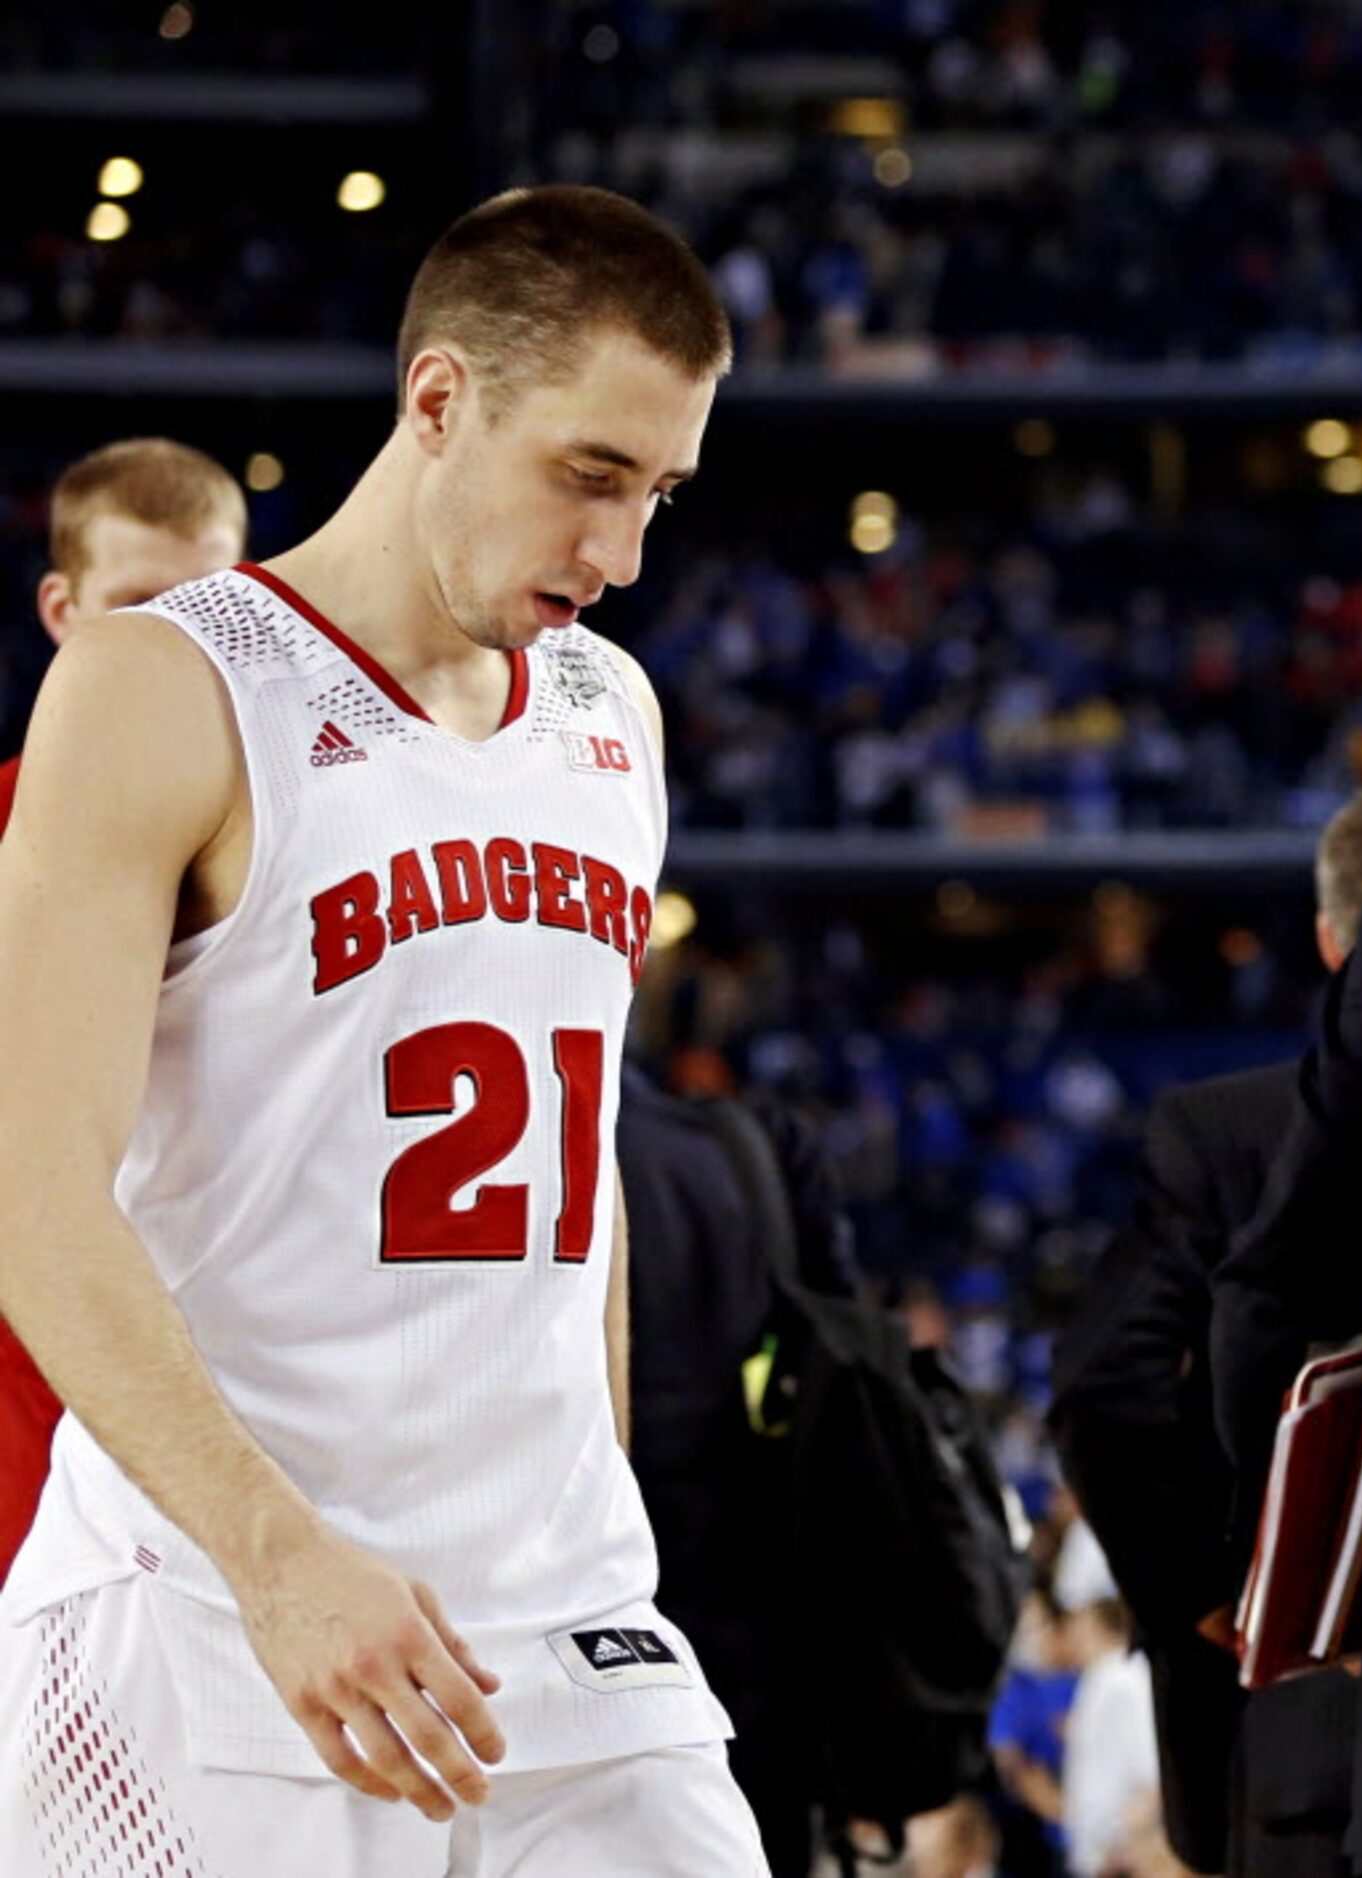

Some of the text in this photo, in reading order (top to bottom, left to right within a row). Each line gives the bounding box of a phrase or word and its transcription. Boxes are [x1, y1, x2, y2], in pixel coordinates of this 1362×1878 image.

[309, 748, 368, 767] adidas
[310, 837, 652, 996] BADGERS
[379, 1020, 604, 1264] 21
